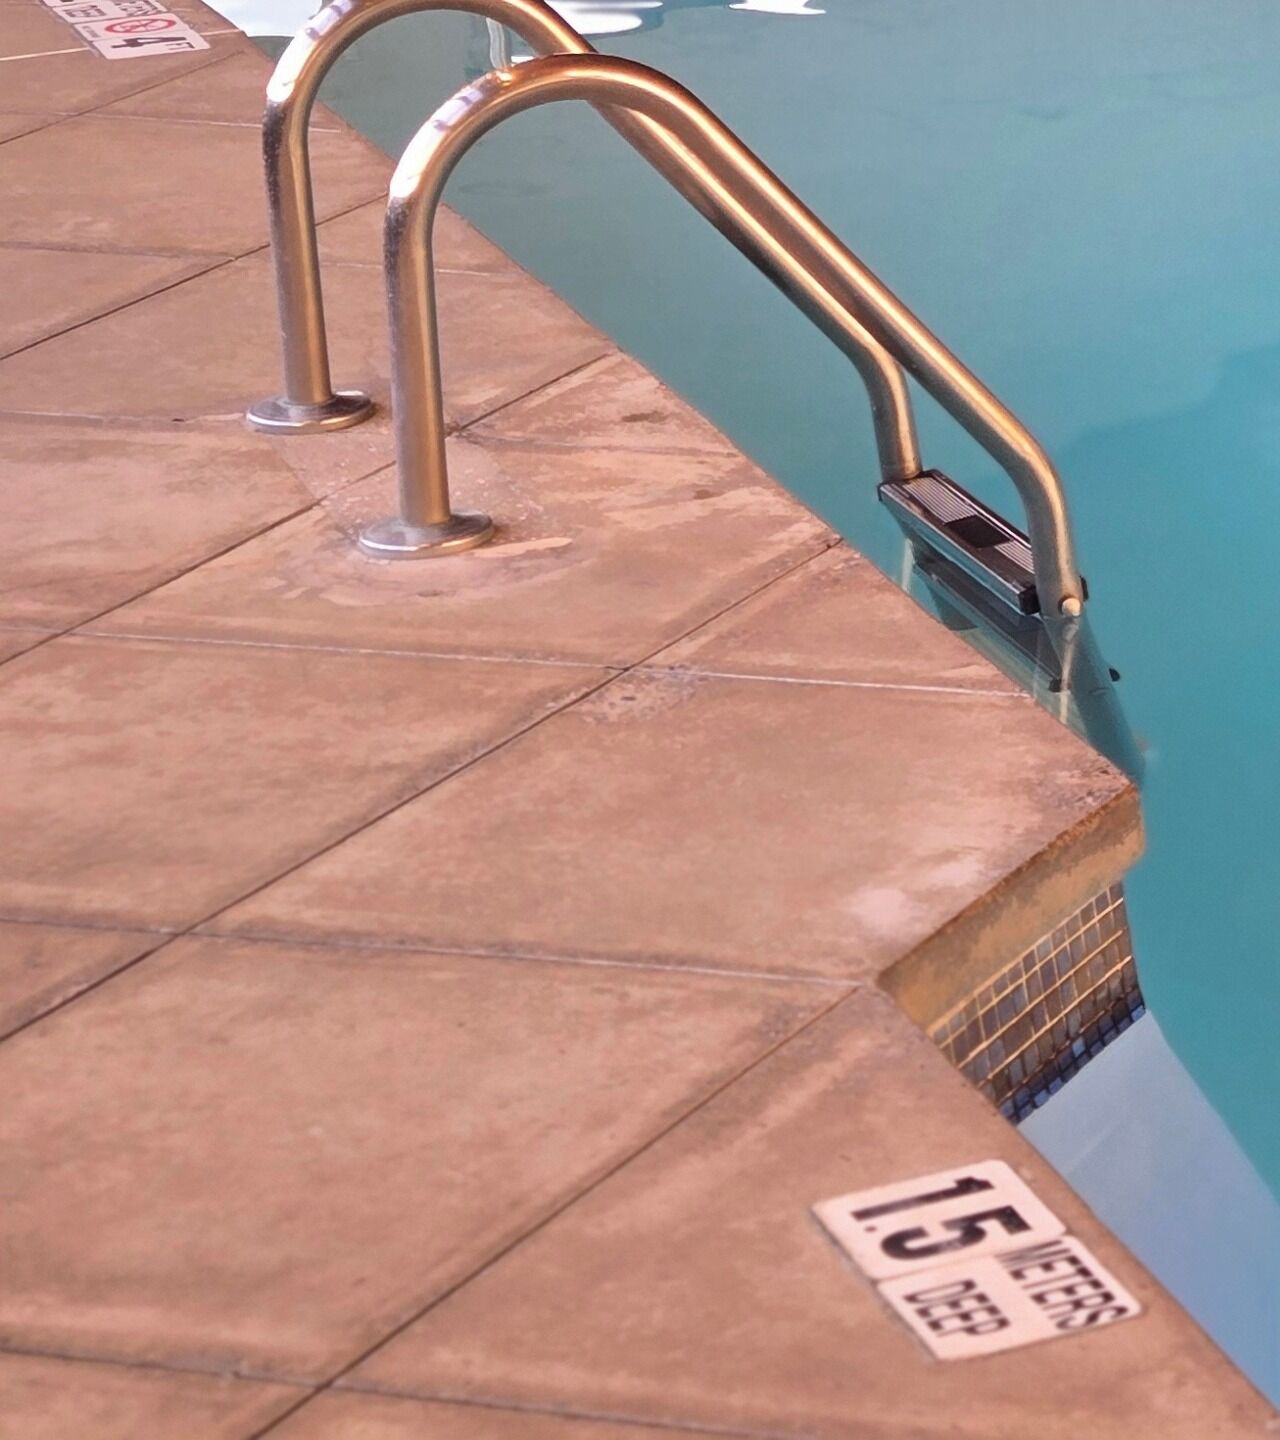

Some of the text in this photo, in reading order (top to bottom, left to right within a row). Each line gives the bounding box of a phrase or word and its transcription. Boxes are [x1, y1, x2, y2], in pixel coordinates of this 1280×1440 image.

[851, 1176, 1032, 1260] 1.5
[903, 1279, 1011, 1338] DEEP
[996, 1239, 1129, 1332] METERS
